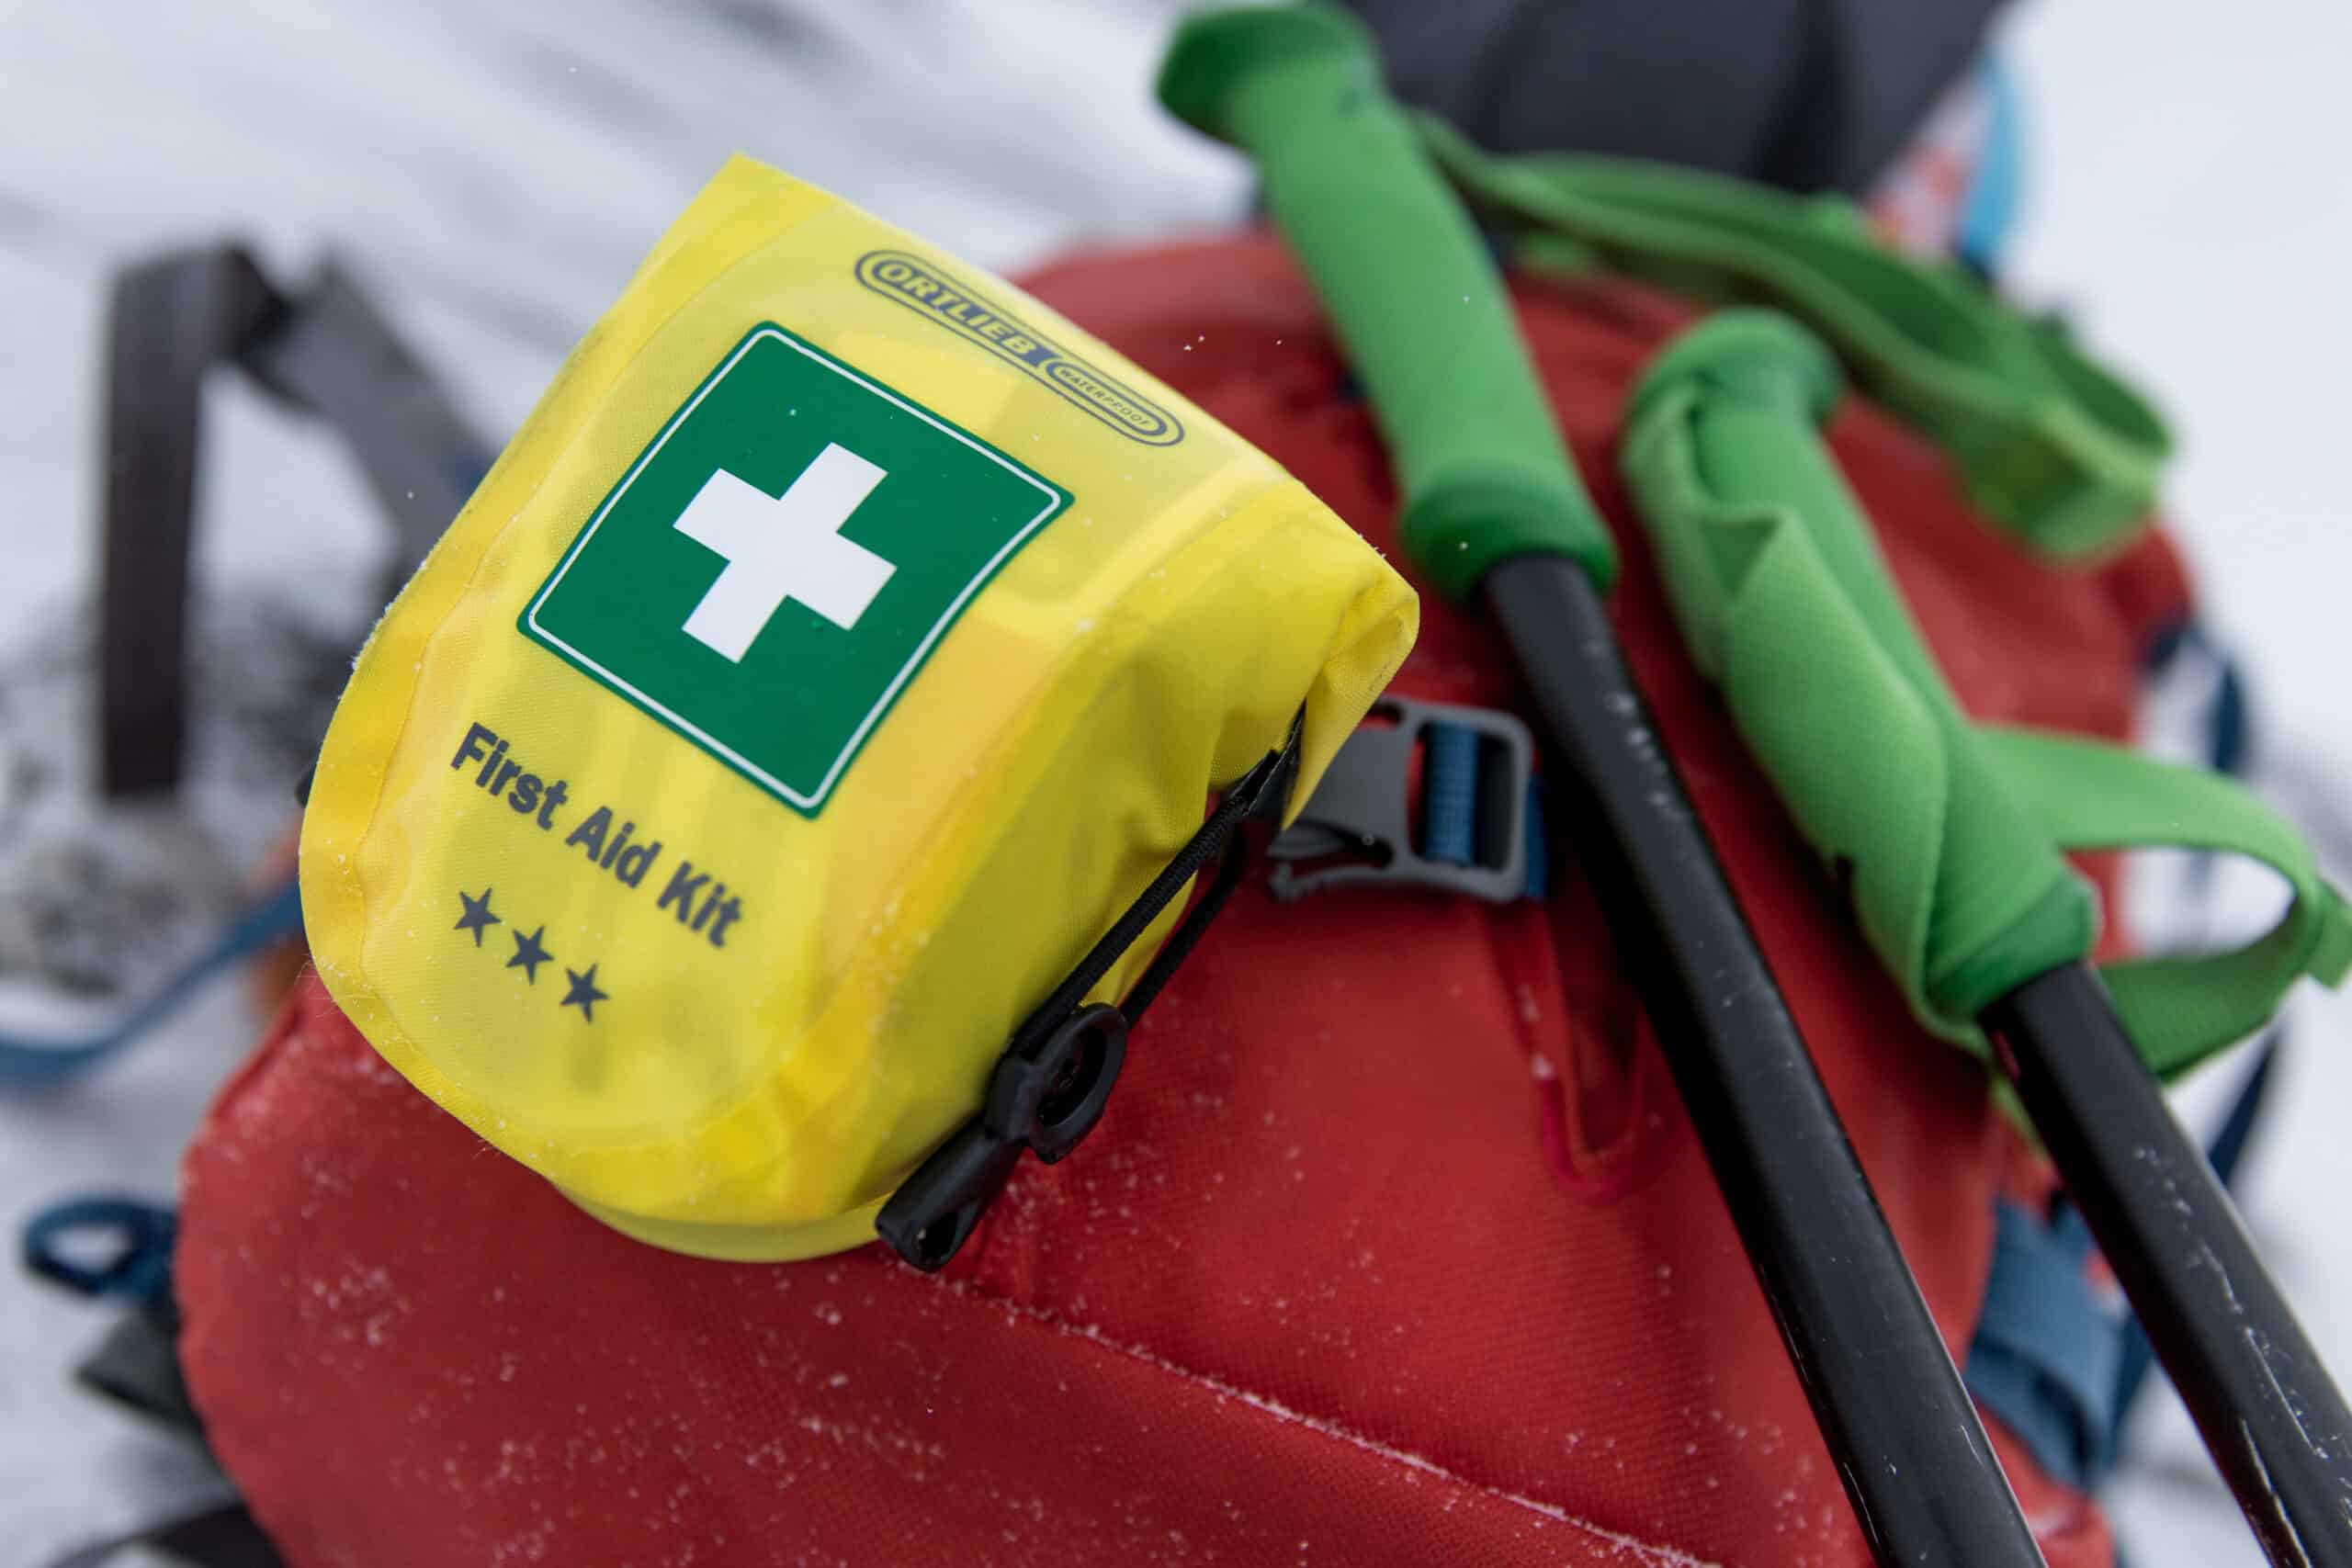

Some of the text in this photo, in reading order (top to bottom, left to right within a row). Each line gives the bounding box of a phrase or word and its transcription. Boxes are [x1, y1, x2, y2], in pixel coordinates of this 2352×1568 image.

[877, 261, 1152, 425] ORTLIEB WATERPROOF
[449, 722, 743, 949] First Aid Kit
